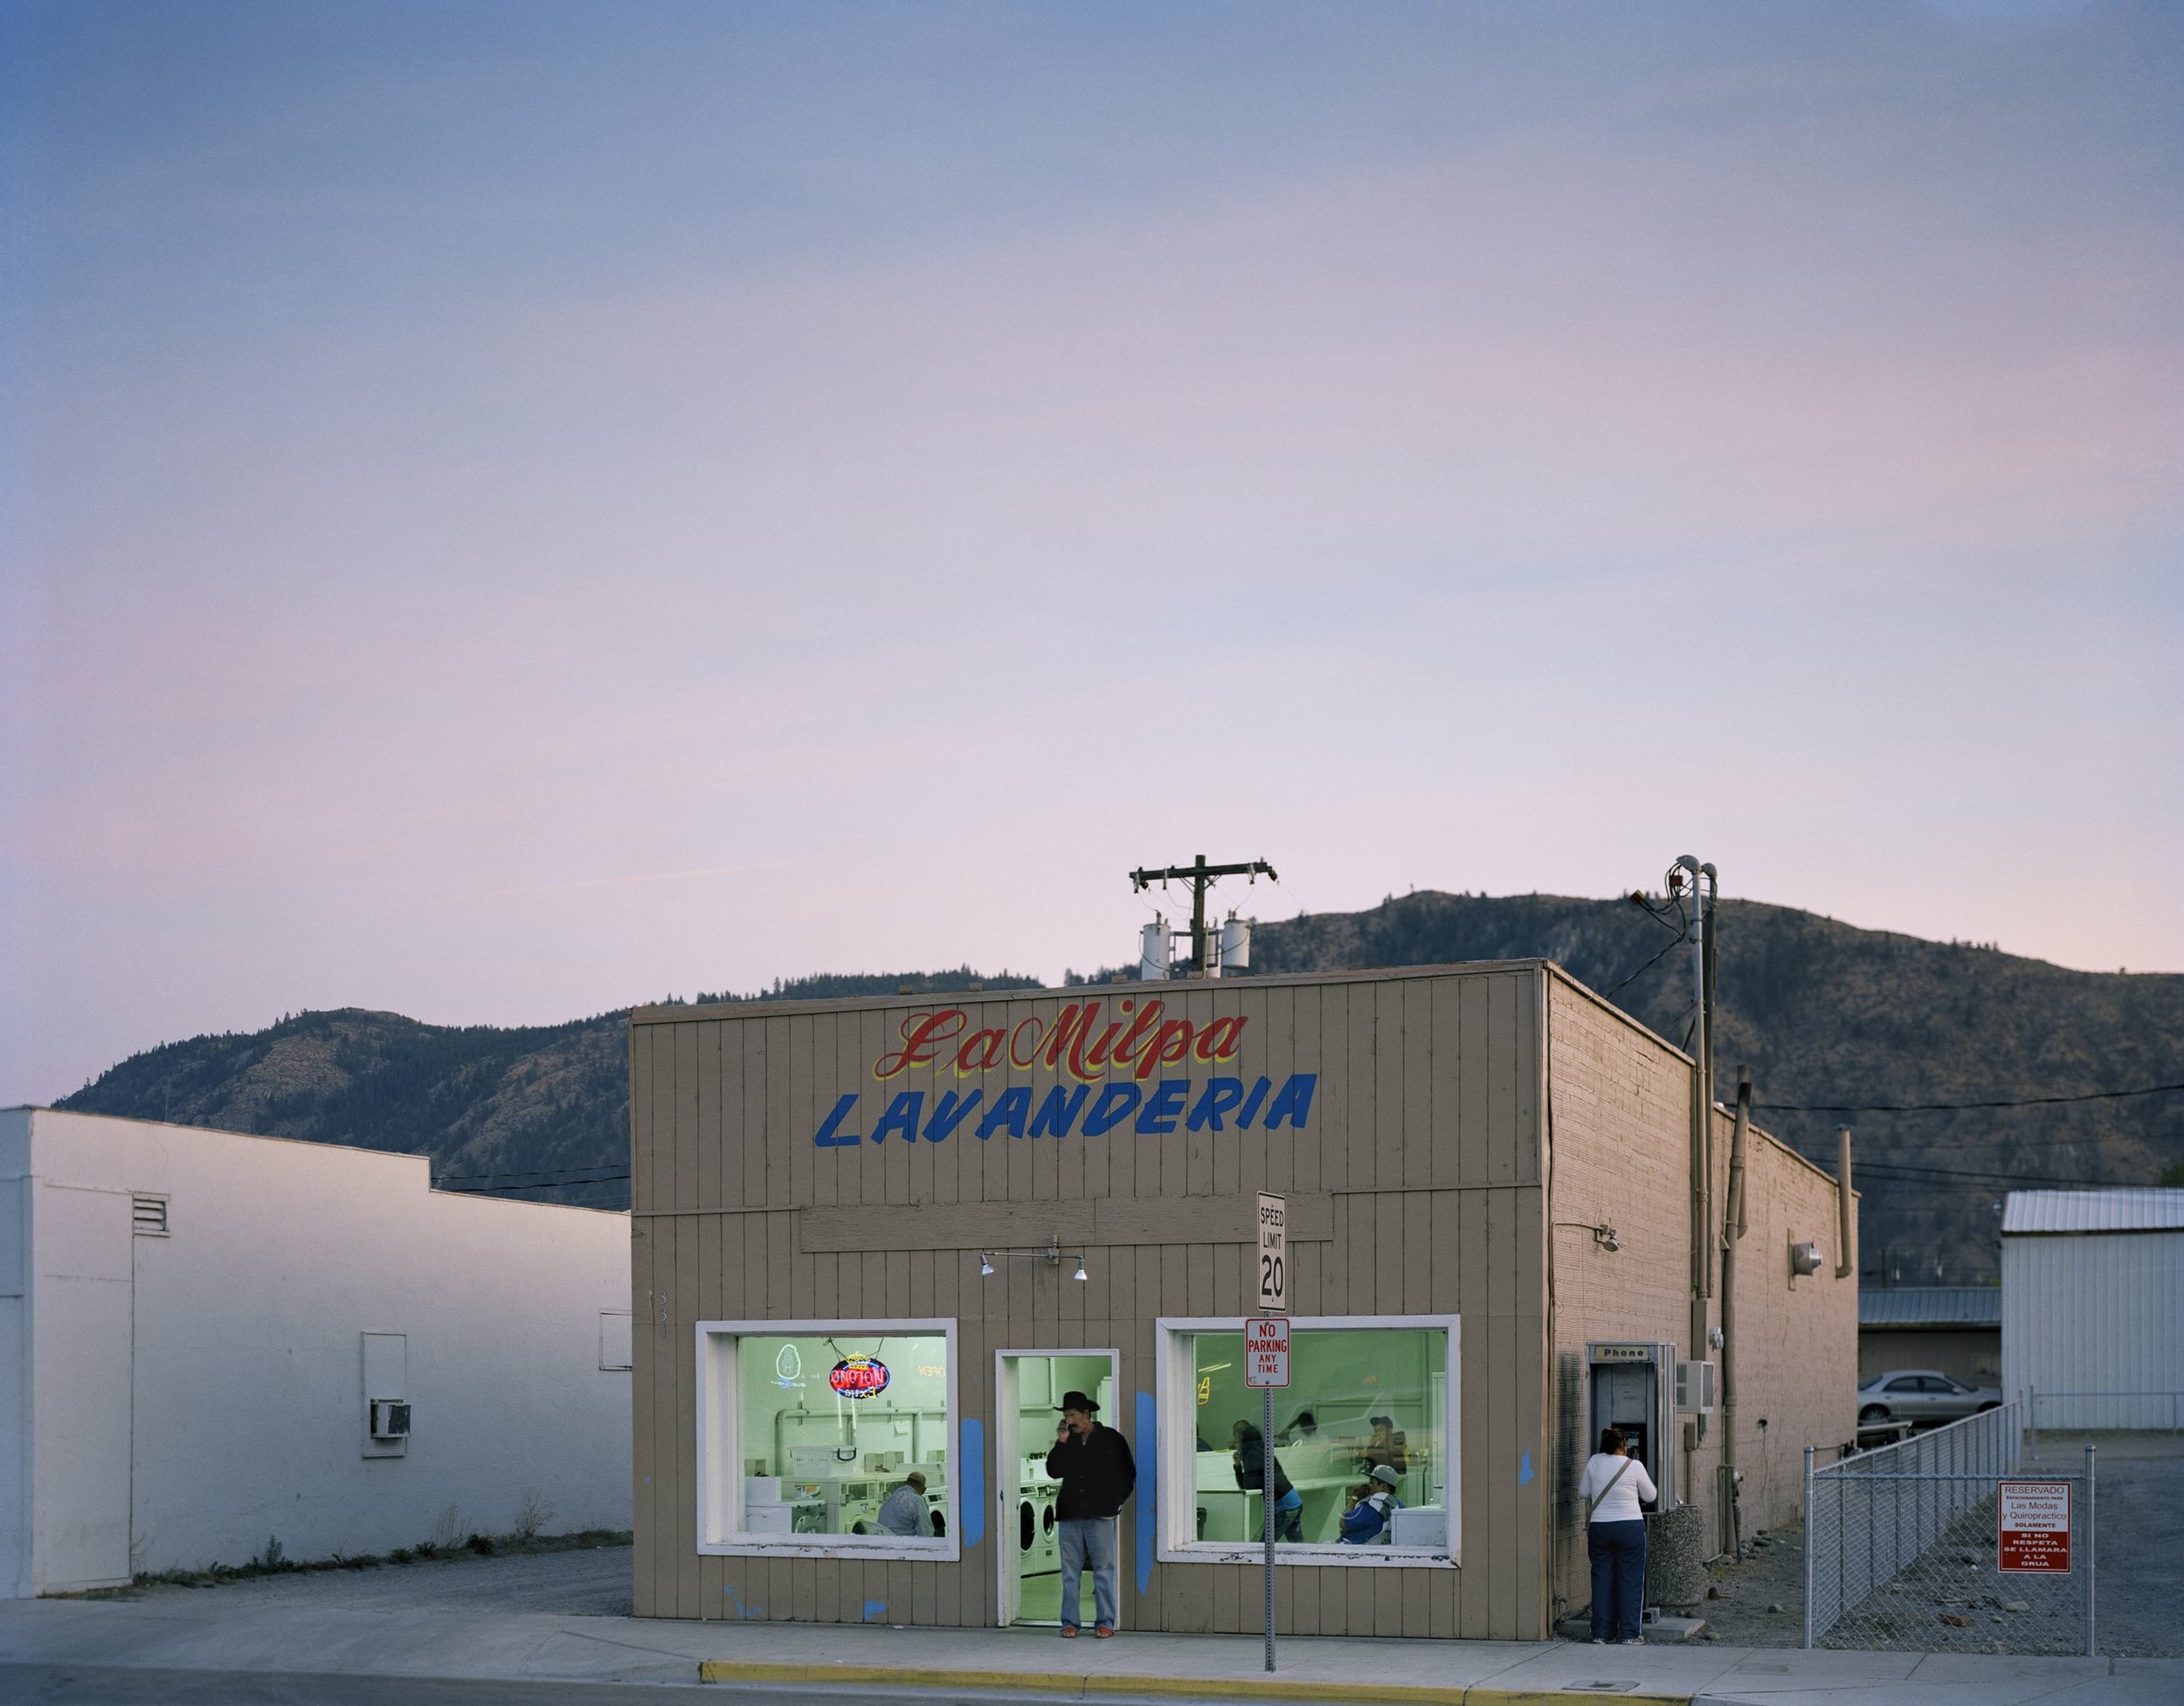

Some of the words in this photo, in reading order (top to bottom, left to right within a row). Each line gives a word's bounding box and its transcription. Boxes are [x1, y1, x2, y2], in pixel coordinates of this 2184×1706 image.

[874, 1008, 1006, 1081] La
[1010, 999, 1248, 1084] Milpa
[813, 1073, 1317, 1148] LAVANDERIA
[1261, 1206, 1284, 1227] SPEED
[1263, 1231, 1282, 1250] LIMIT
[1261, 1254, 1283, 1297] 20
[1259, 1324, 1275, 1337] NO
[1248, 1339, 1287, 1352] PARKING
[1259, 1354, 1276, 1363] ANY
[1257, 1364, 1278, 1373] TIME
[2005, 1486, 2064, 1495] RESERVADO
[2009, 1511, 2067, 1521] Quiropractico
